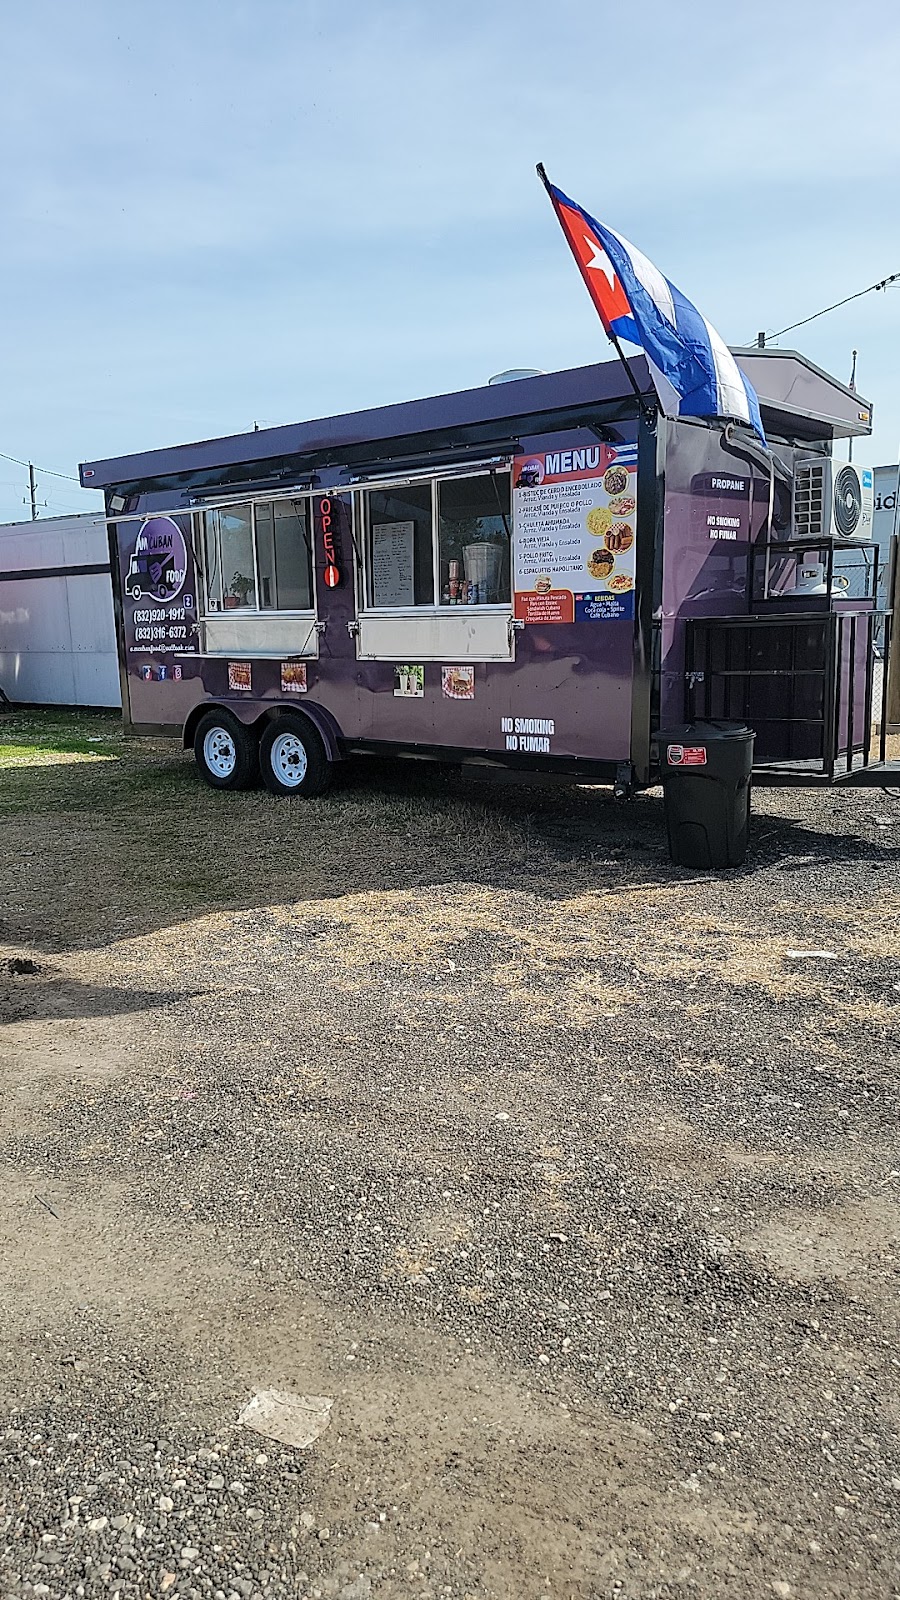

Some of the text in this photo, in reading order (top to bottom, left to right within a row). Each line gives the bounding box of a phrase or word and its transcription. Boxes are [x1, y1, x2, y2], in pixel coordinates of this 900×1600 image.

[545, 446, 600, 475] MENU
[711, 478, 745, 491] PROPANE
[576, 499, 592, 507] POLLO
[707, 516, 740, 528] NO SMOKING
[320, 498, 336, 566] OPEN
[710, 529, 737, 540] NO FUMAR
[552, 564, 584, 572] NAPOLITANO
[166, 569, 184, 584] FOOD
[133, 608, 186, 625] (832)920-1912
[135, 626, 187, 642] (832)316-6372
[501, 717, 555, 735] NO SMOKING
[506, 735, 550, 753] NO FUMAR
